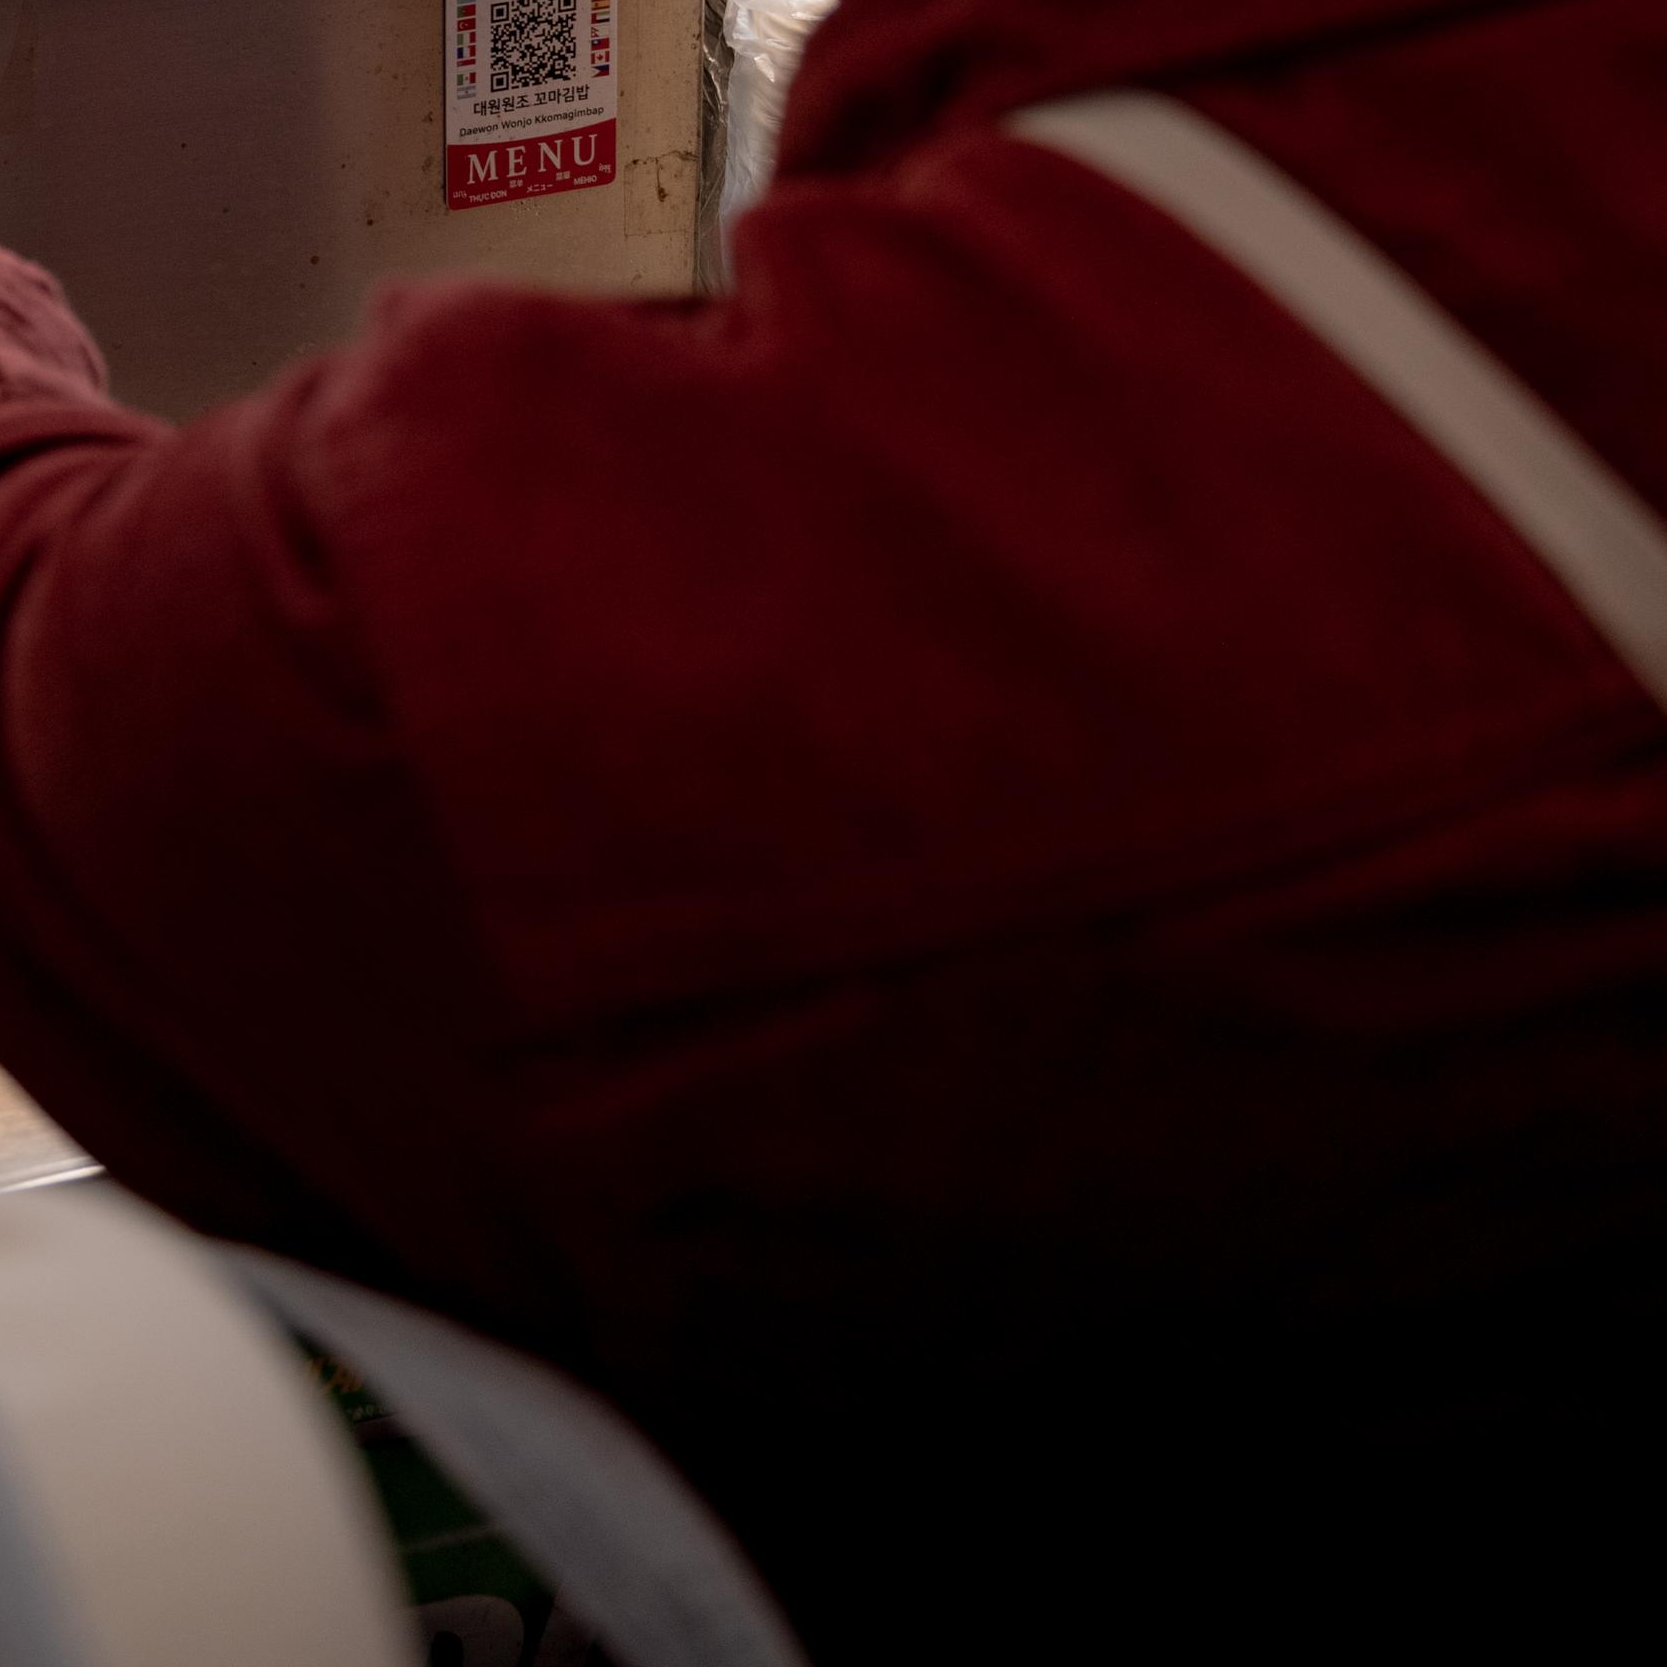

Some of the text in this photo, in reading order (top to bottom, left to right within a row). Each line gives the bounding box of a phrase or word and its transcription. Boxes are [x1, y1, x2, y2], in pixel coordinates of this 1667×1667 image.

[473, 83, 590, 117] 대원원조 꼬마김밥
[459, 105, 605, 137] Daewon Wonjo Kkomagimbap
[467, 133, 598, 185] MENU
